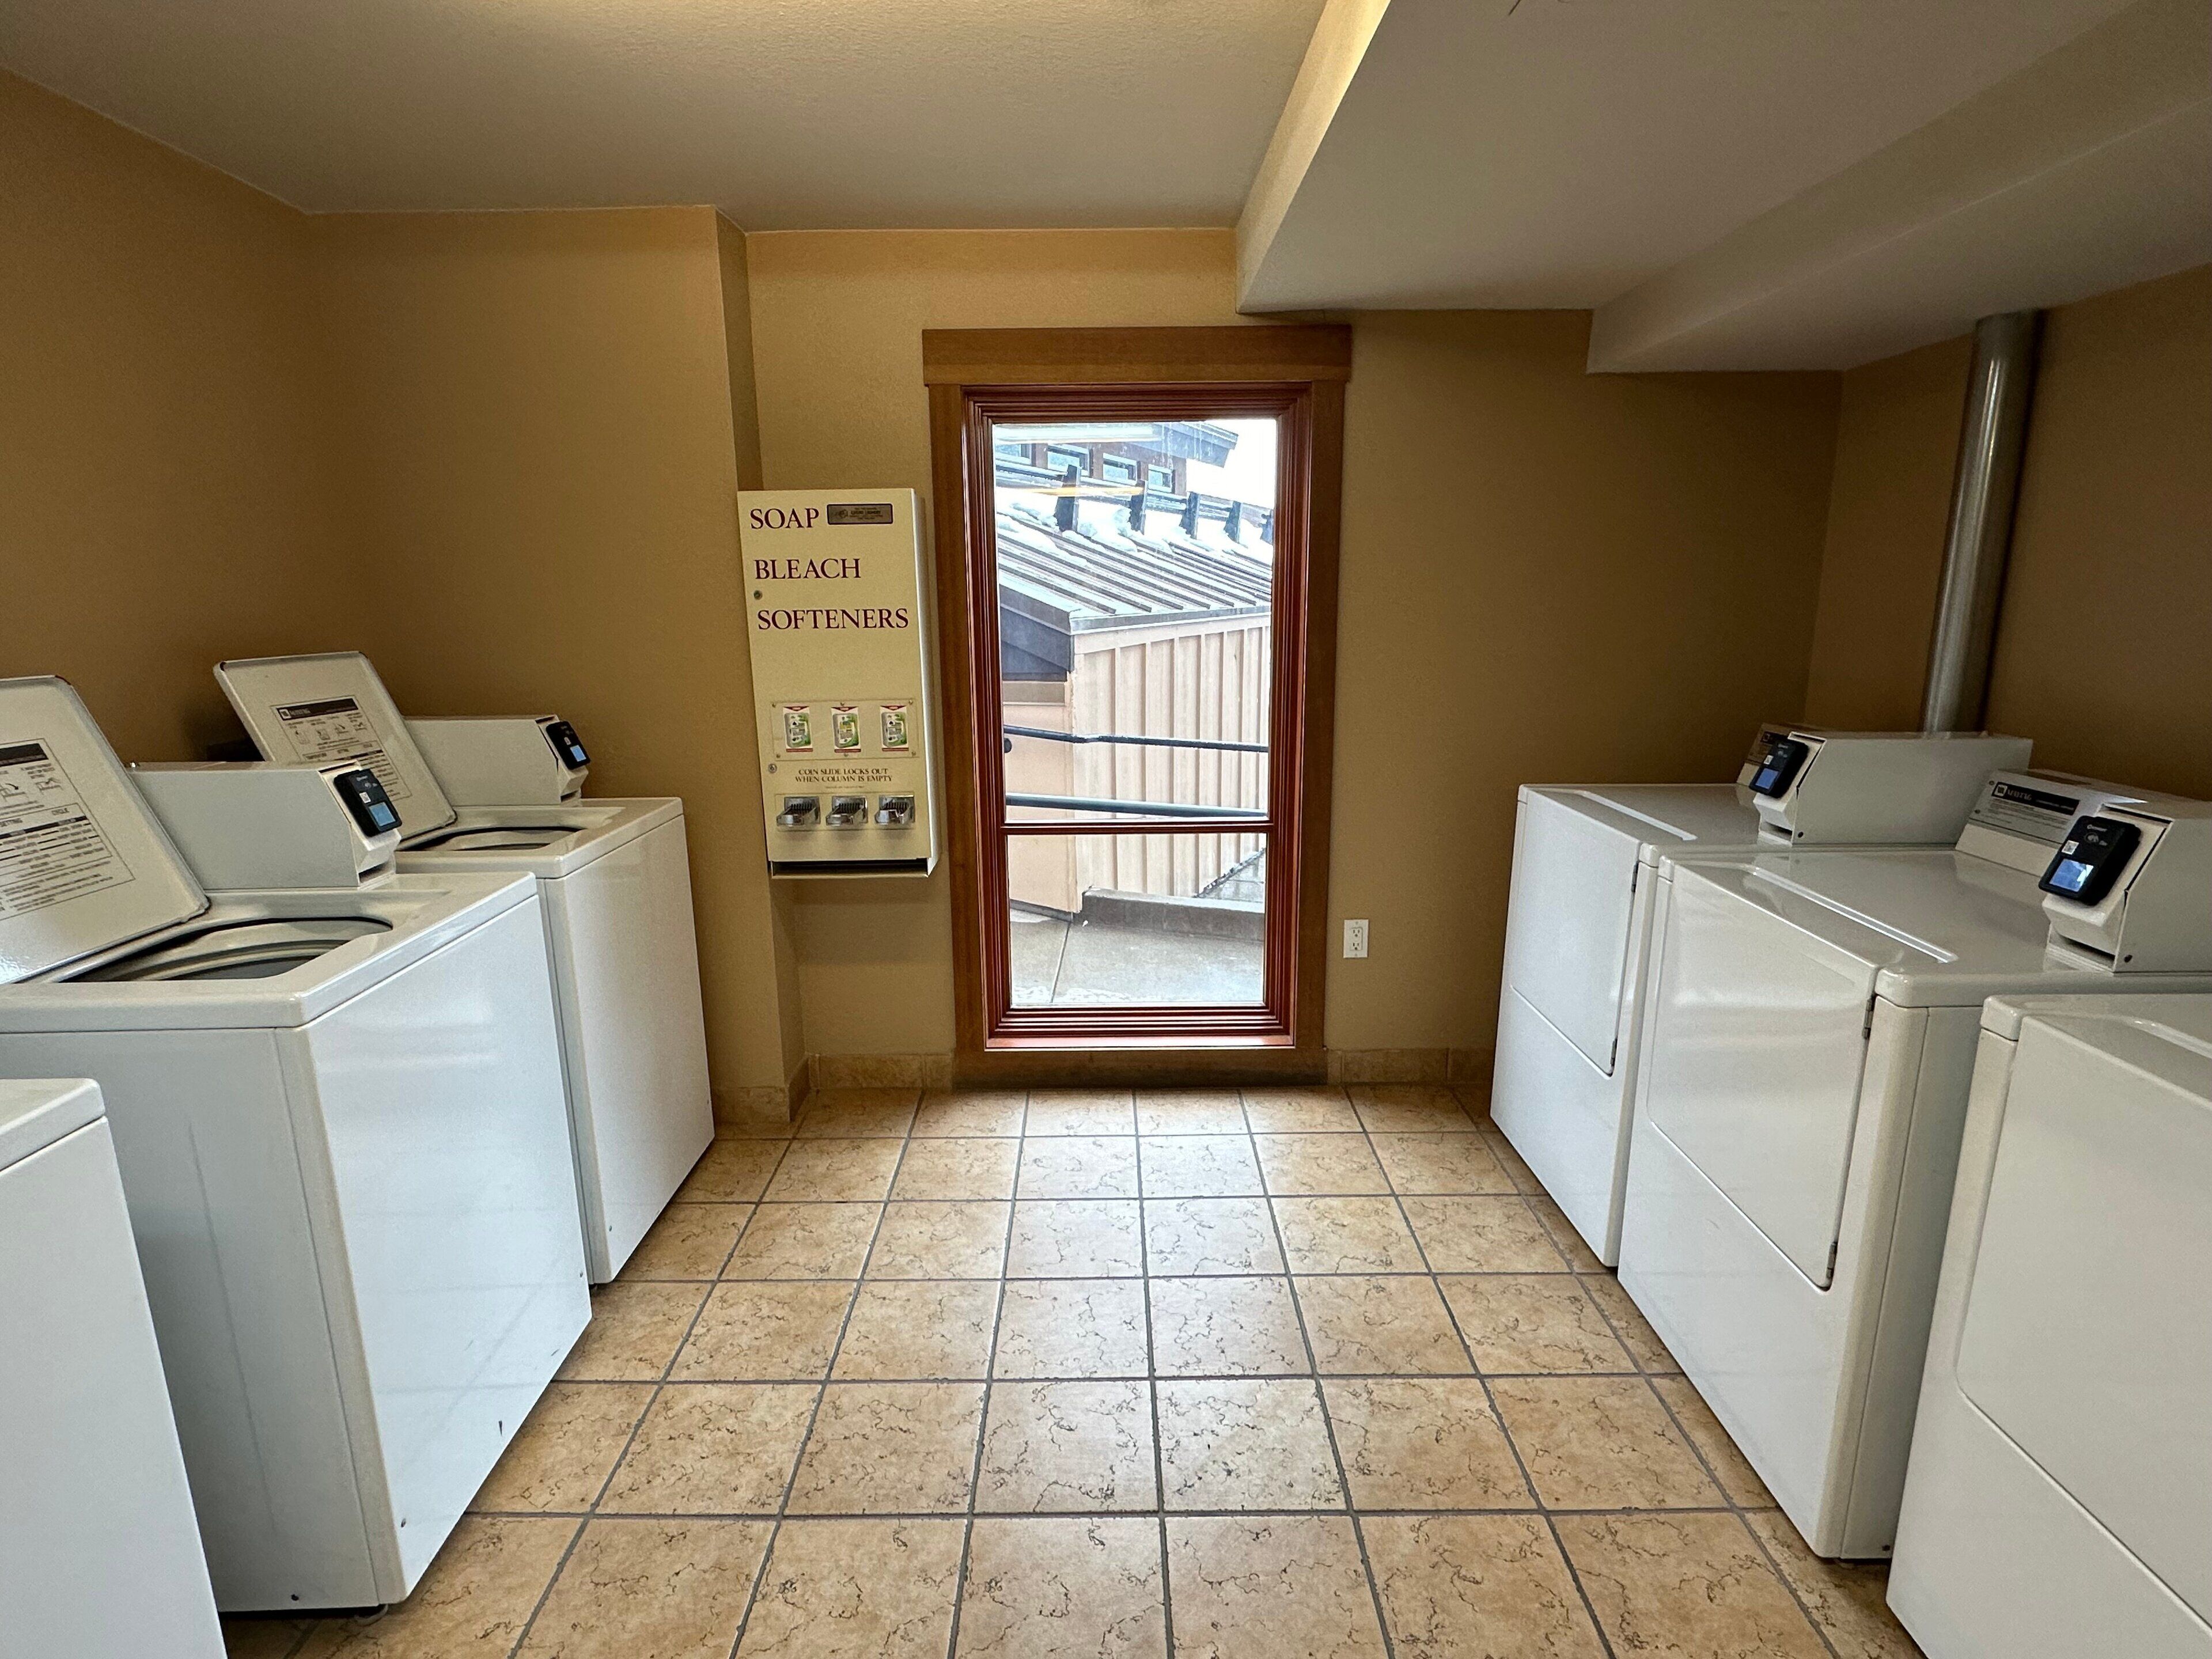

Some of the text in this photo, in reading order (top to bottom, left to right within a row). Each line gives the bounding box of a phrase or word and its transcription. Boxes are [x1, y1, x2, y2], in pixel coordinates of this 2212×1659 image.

[751, 508, 819, 529] SOAP
[755, 559, 861, 579] BLEACH
[758, 608, 908, 630] SOFTENERS
